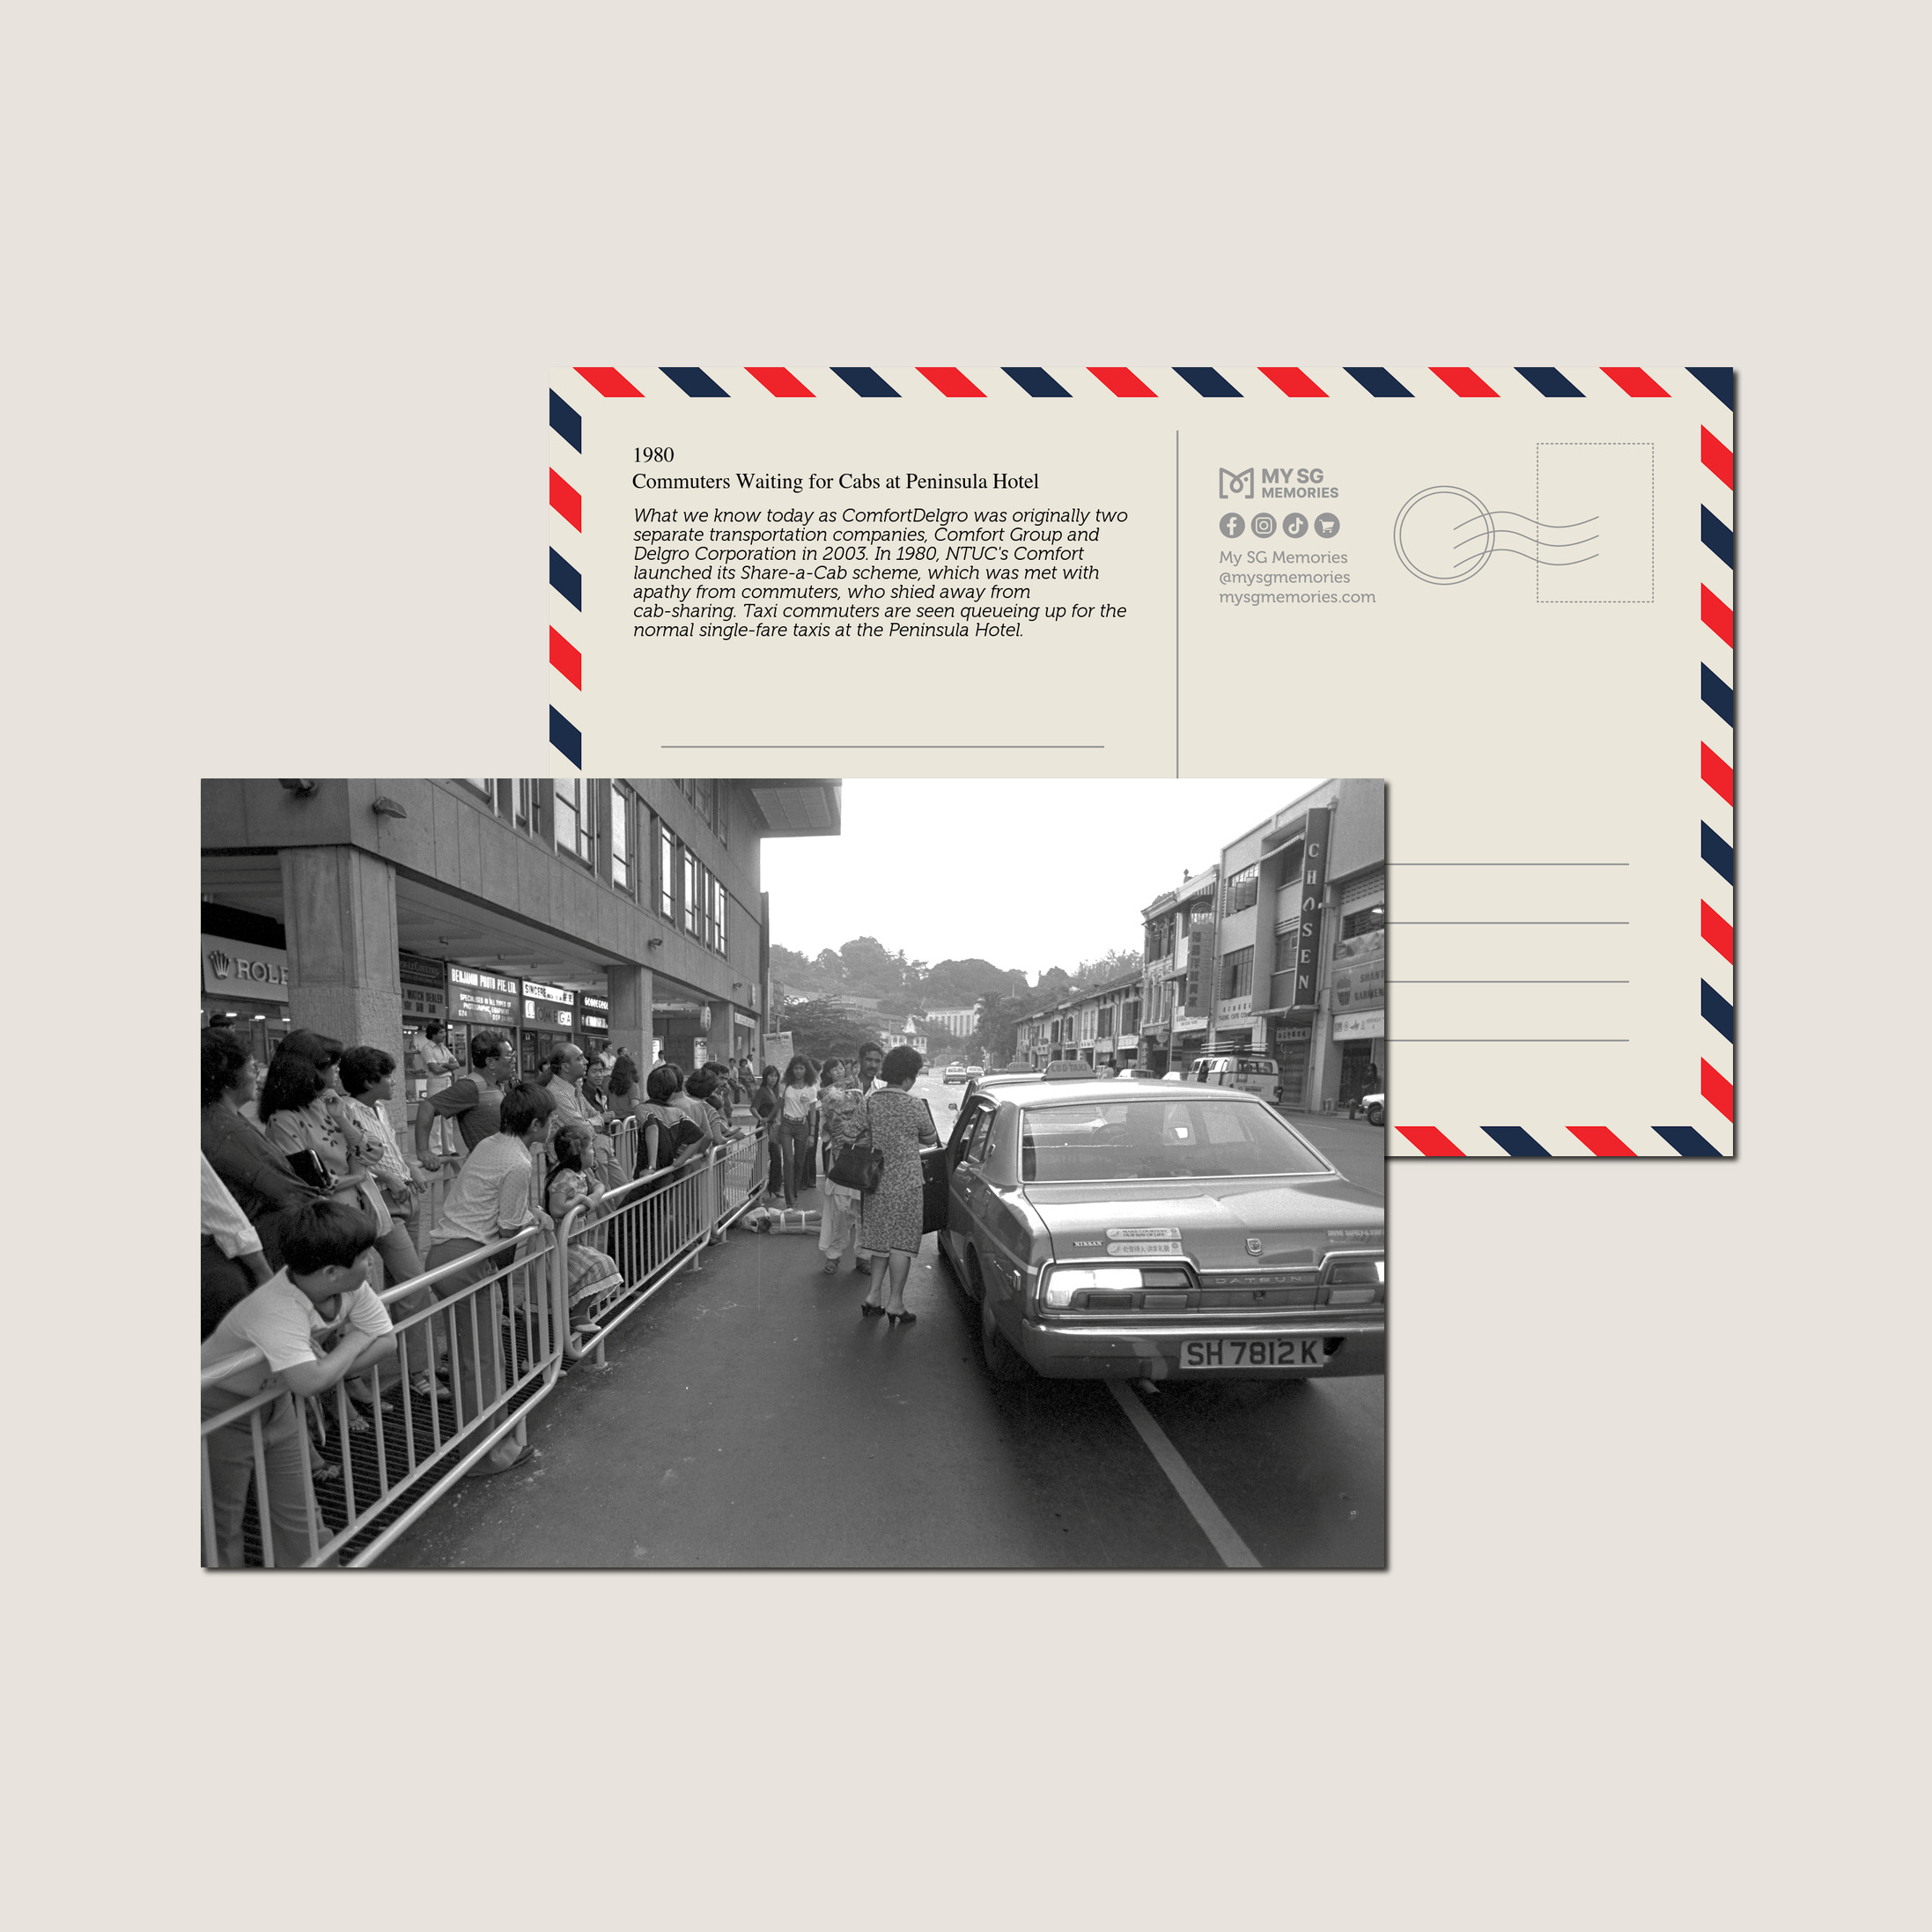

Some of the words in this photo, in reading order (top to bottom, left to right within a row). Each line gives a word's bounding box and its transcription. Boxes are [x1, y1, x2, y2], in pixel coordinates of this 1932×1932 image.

[635, 446, 675, 463] 1980
[632, 473, 731, 490] Commuters
[735, 473, 803, 494] Waiting
[808, 473, 835, 490] for
[838, 473, 881, 490] Cabs
[885, 475, 901, 489] at
[905, 473, 988, 490] Peninsula
[992, 473, 1039, 490] Hotel
[1261, 468, 1294, 484] MY
[1296, 468, 1324, 484] SG
[1261, 487, 1339, 498] MEMORIES
[634, 507, 679, 523] What
[682, 511, 709, 523] we
[713, 507, 762, 523] know
[767, 507, 815, 527] today
[818, 511, 837, 523] as
[842, 507, 969, 527] ComfortDelgro
[974, 511, 1007, 523] was
[1012, 507, 1091, 527] originally
[1095, 508, 1128, 523] two
[633, 527, 704, 546] separate
[710, 527, 827, 546] transportation
[832, 527, 928, 546] companies,
[934, 527, 1006, 542] Comfort
[1009, 527, 1063, 546] Group
[1066, 527, 1100, 542] and
[634, 546, 689, 564] Delgro
[695, 546, 796, 564] Corporation
[801, 546, 817, 561] in
[822, 546, 868, 561] 2003.
[874, 546, 891, 561] In
[896, 546, 940, 563] 1980,
[945, 546, 1009, 561] NTUC's
[1014, 546, 1085, 561] Comfort
[1219, 550, 1243, 567] My
[1247, 550, 1268, 564] SG
[1272, 550, 1348, 564] Memories
[633, 564, 712, 580] launched
[717, 564, 736, 580] its
[740, 564, 848, 580] Share-a-Cab
[852, 564, 921, 582] scheme,
[927, 564, 979, 580] which
[985, 568, 1020, 580] was
[1024, 565, 1058, 580] met
[1062, 564, 1099, 580] with
[1219, 570, 1351, 587] @mysgmemories
[632, 584, 692, 603] apathy
[696, 584, 736, 599] from
[741, 585, 841, 601] commuters,
[847, 584, 886, 599] who
[890, 584, 936, 599] shied
[939, 587, 986, 603] away
[991, 584, 1030, 599] from
[1219, 590, 1376, 607] mysgmemories.com
[633, 603, 736, 622] cab-sharing.
[743, 603, 778, 618] Taxi
[783, 603, 881, 618] commuters
[884, 606, 911, 618] are
[916, 606, 955, 618] seen
[960, 603, 1041, 622] queueing
[1044, 606, 1066, 622] up
[1072, 603, 1095, 618] for
[1100, 603, 1127, 618] the
[633, 622, 695, 638] normal
[698, 622, 788, 641] single-fare
[793, 622, 830, 638] taxis
[835, 623, 852, 637] at
[857, 622, 884, 638] the
[889, 622, 969, 638] Peninsula
[975, 622, 1023, 638] Hotel.
[1298, 843, 1320, 990] CHOSEN
[233, 957, 289, 985] ROLE
[451, 968, 478, 986] BENJAMIN
[479, 975, 496, 990] PHOTO
[1360, 970, 1383, 983] SHANT
[407, 989, 424, 1001] WATCH
[426, 992, 443, 1004] DEALER
[525, 984, 546, 998] SINCERE
[1354, 988, 1383, 1000] GARMEN
[538, 1008, 571, 1024] OMEGA
[1068, 1063, 1088, 1072] TAXI
[1187, 1342, 1223, 1365] SH
[1230, 1341, 1294, 1365] 7812
[1302, 1340, 1317, 1364] K
